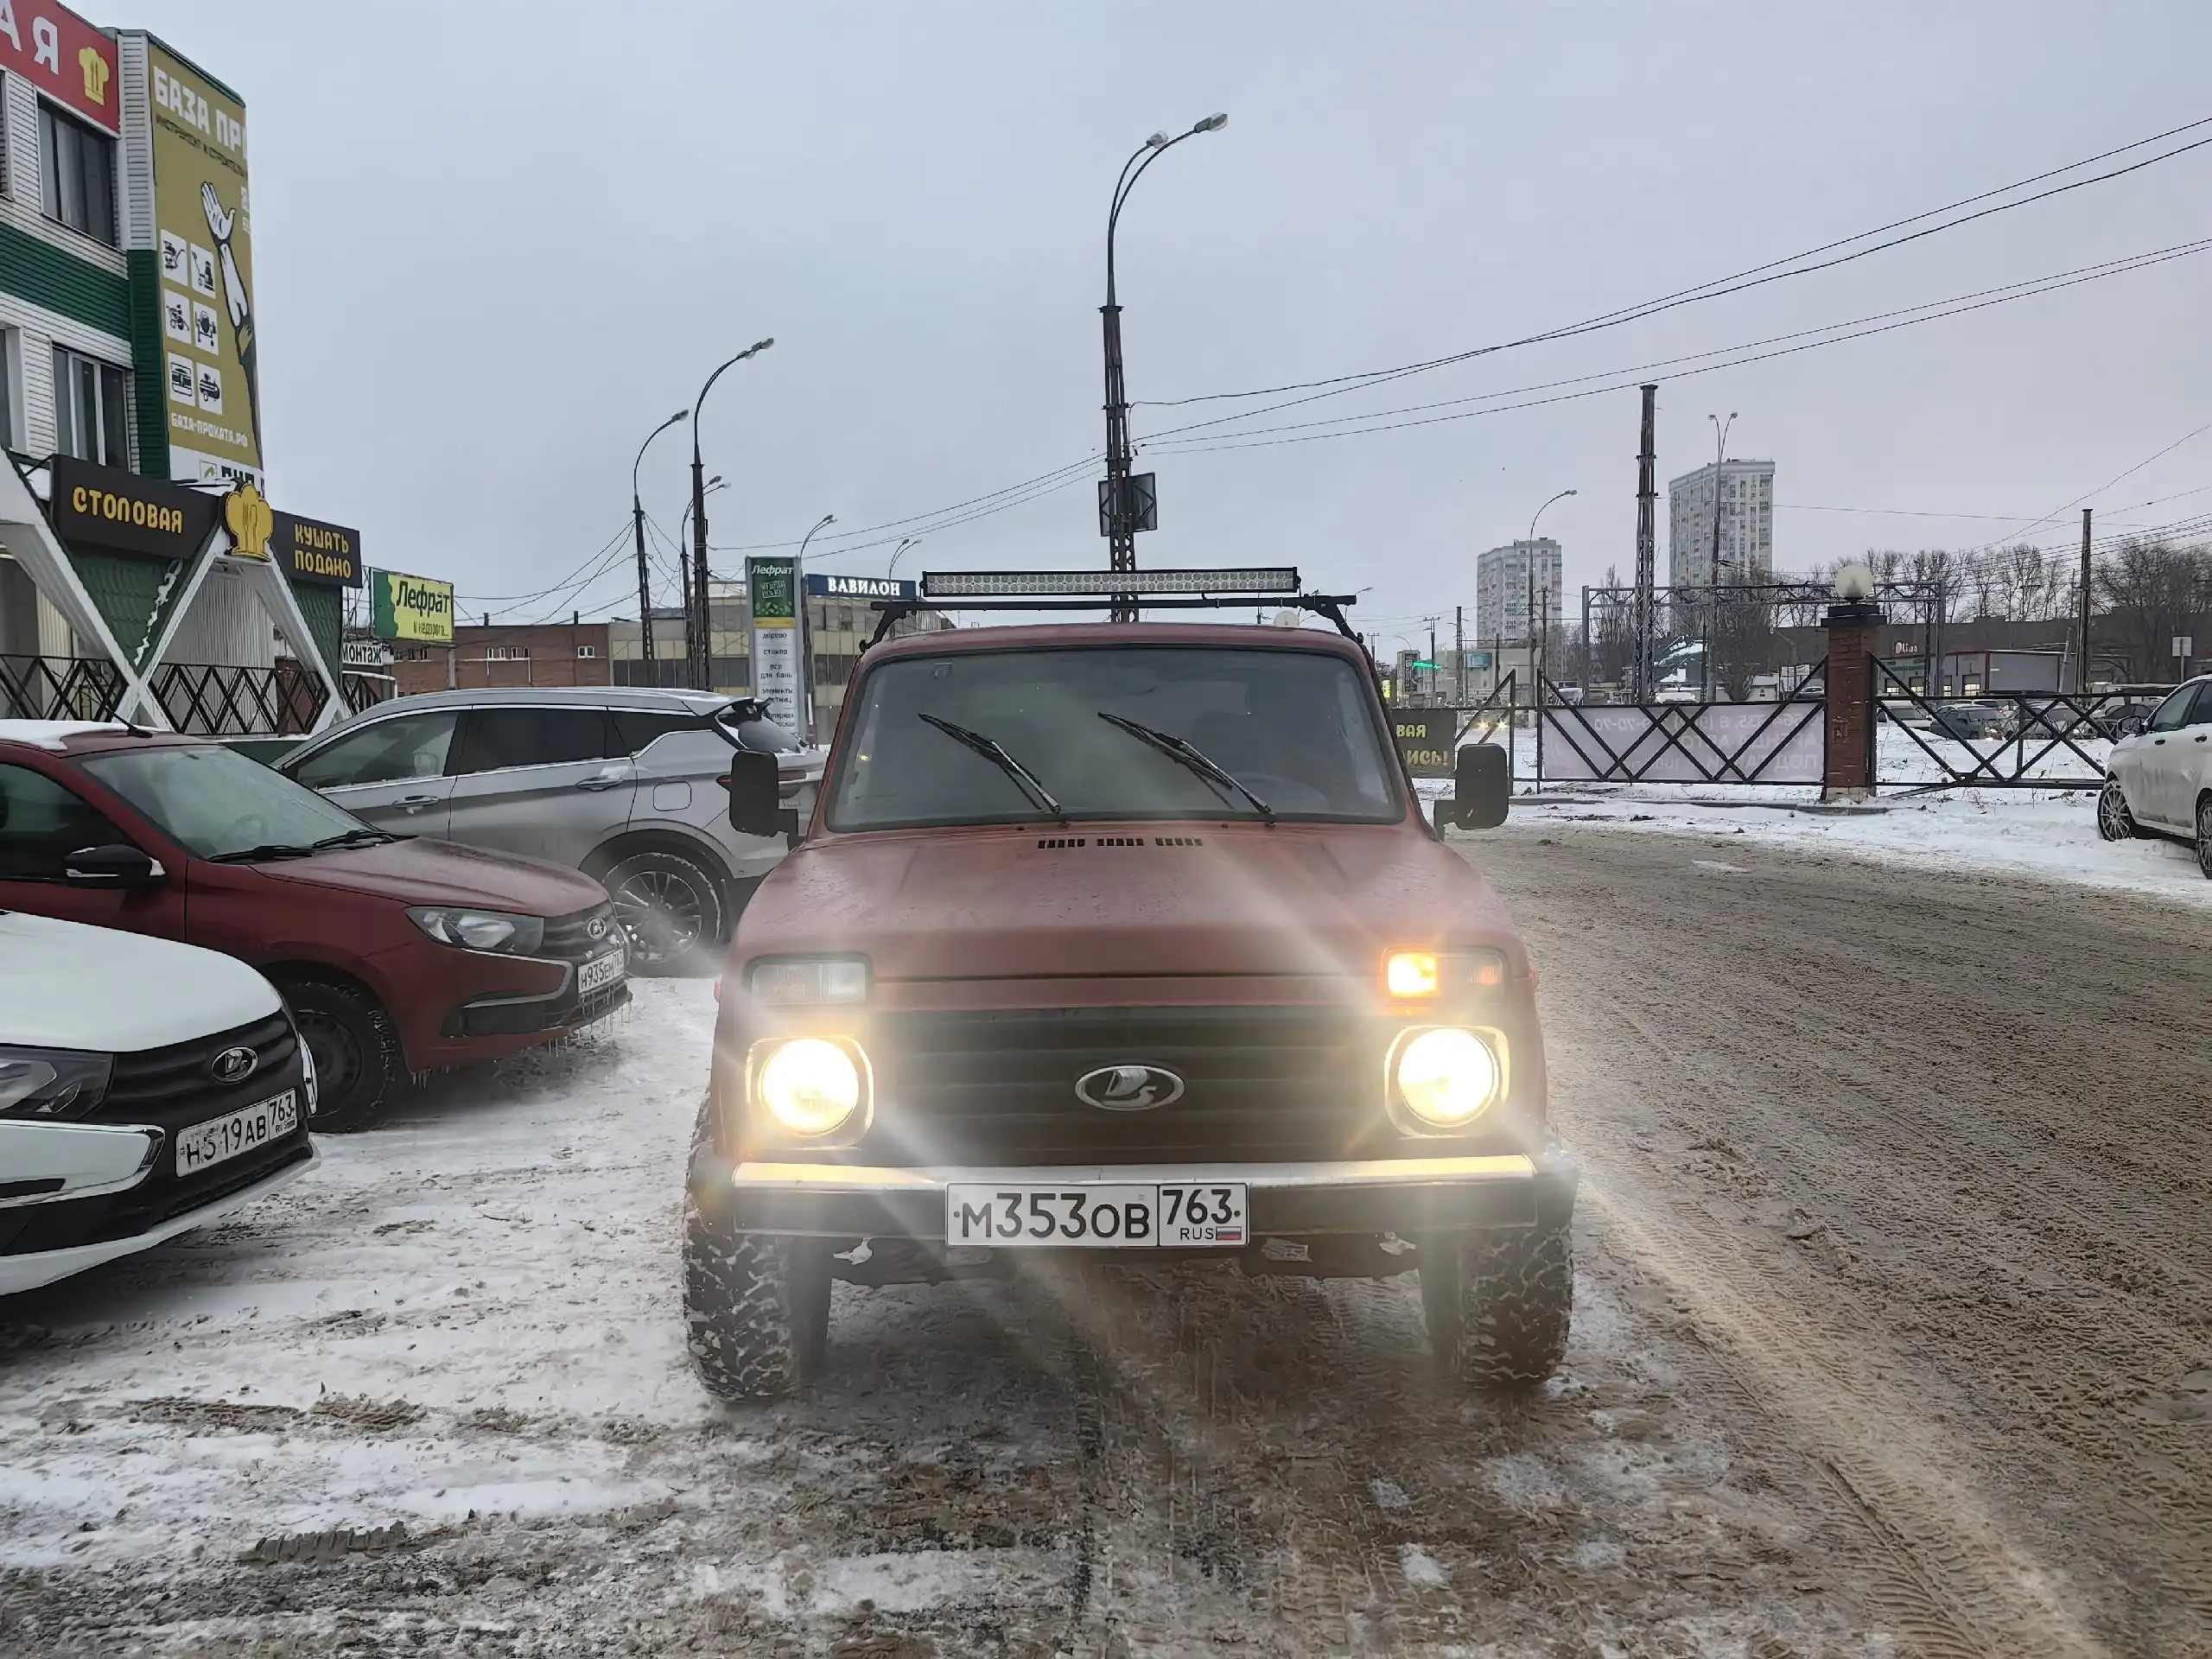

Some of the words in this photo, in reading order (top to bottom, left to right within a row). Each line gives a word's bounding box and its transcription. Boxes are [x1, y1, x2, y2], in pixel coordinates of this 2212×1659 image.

[153, 66, 211, 135] БАЗА
[73, 486, 183, 534] СТОЛОВАЯ
[295, 524, 349, 554] КУШАТЬ
[295, 550, 352, 579] ПОДАНО
[752, 564, 794, 576] Лефрат
[397, 581, 450, 618] Лефрат
[828, 576, 900, 596] ВАВИЛОН
[1396, 724, 1427, 738] ВАЯ
[1407, 749, 1449, 766] ИСЬ!
[269, 1094, 294, 1126] 763
[1161, 1189, 1232, 1225] 763
[1179, 1228, 1214, 1241] RUS
